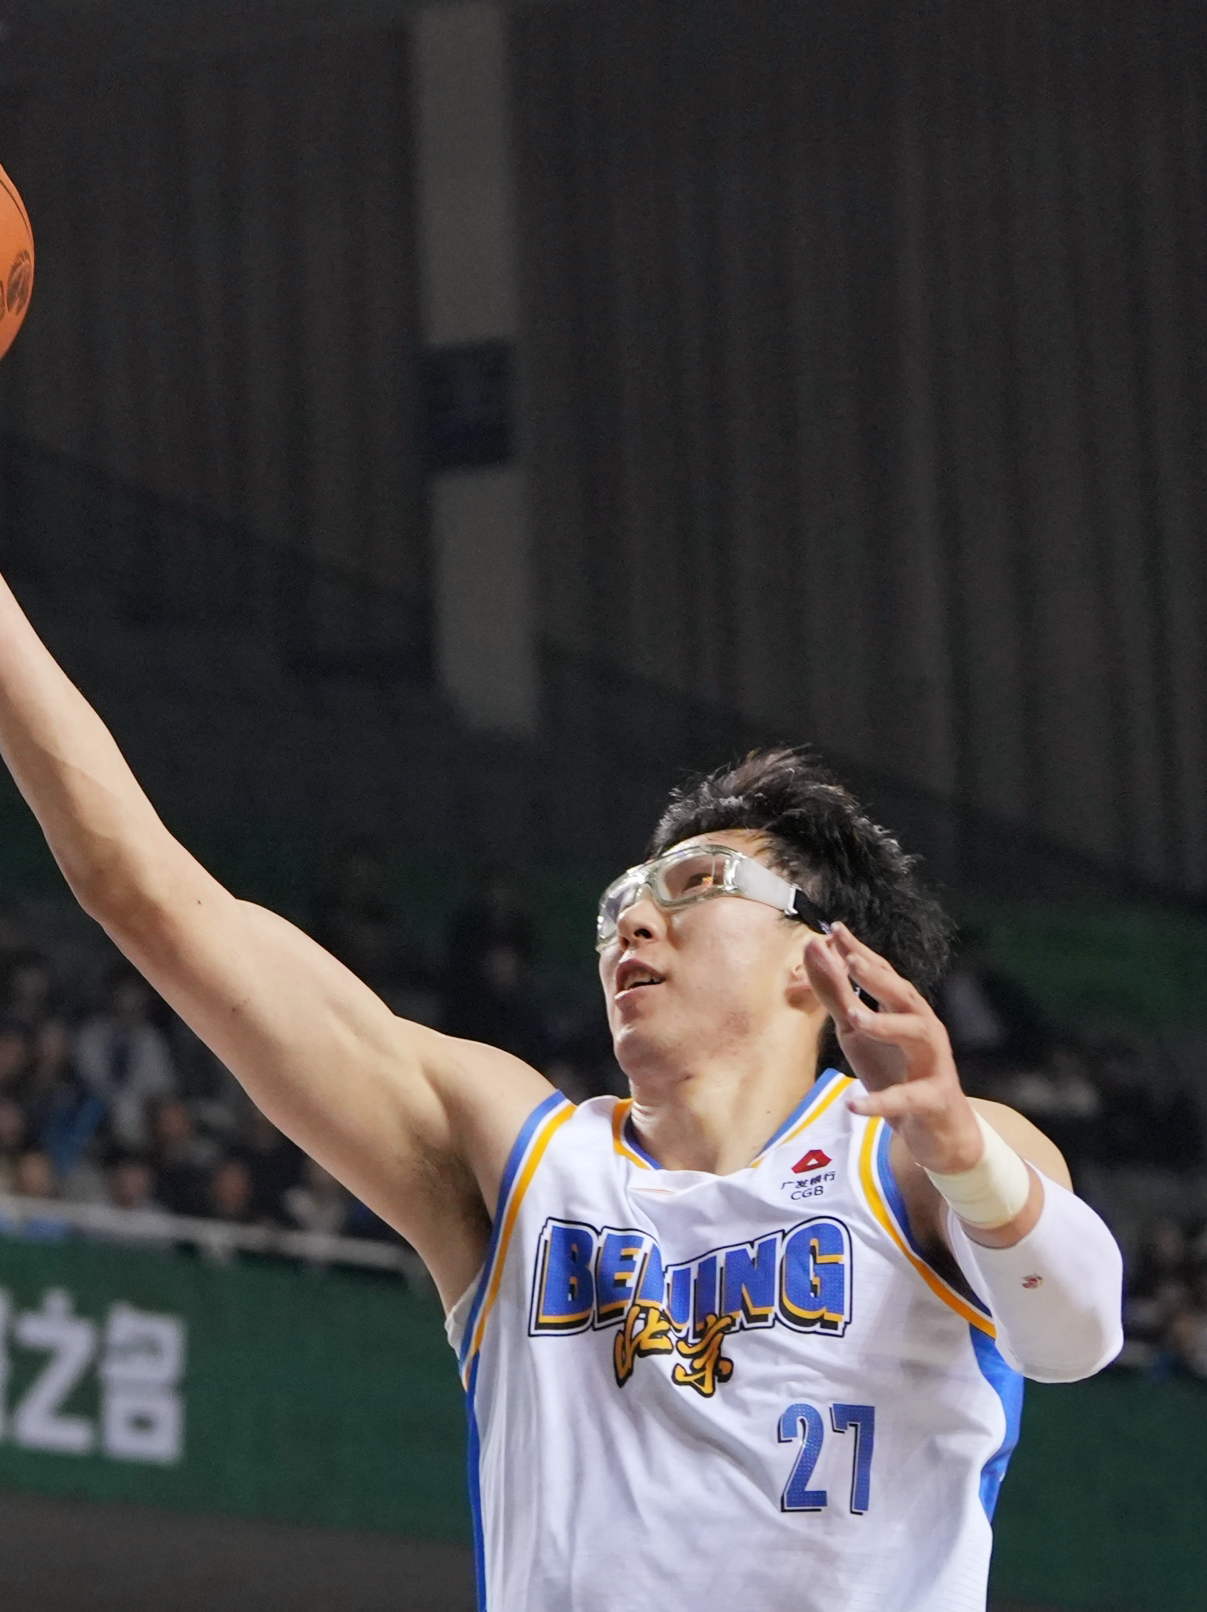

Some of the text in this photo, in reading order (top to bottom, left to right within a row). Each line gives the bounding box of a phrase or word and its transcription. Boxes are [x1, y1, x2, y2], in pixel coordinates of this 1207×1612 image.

[780, 1171, 836, 1190] 广发银行
[790, 1185, 824, 1201] CGB
[528, 1216, 852, 1341] BEIJING
[614, 1304, 734, 1398] 北京
[777, 1402, 876, 1516] 27
